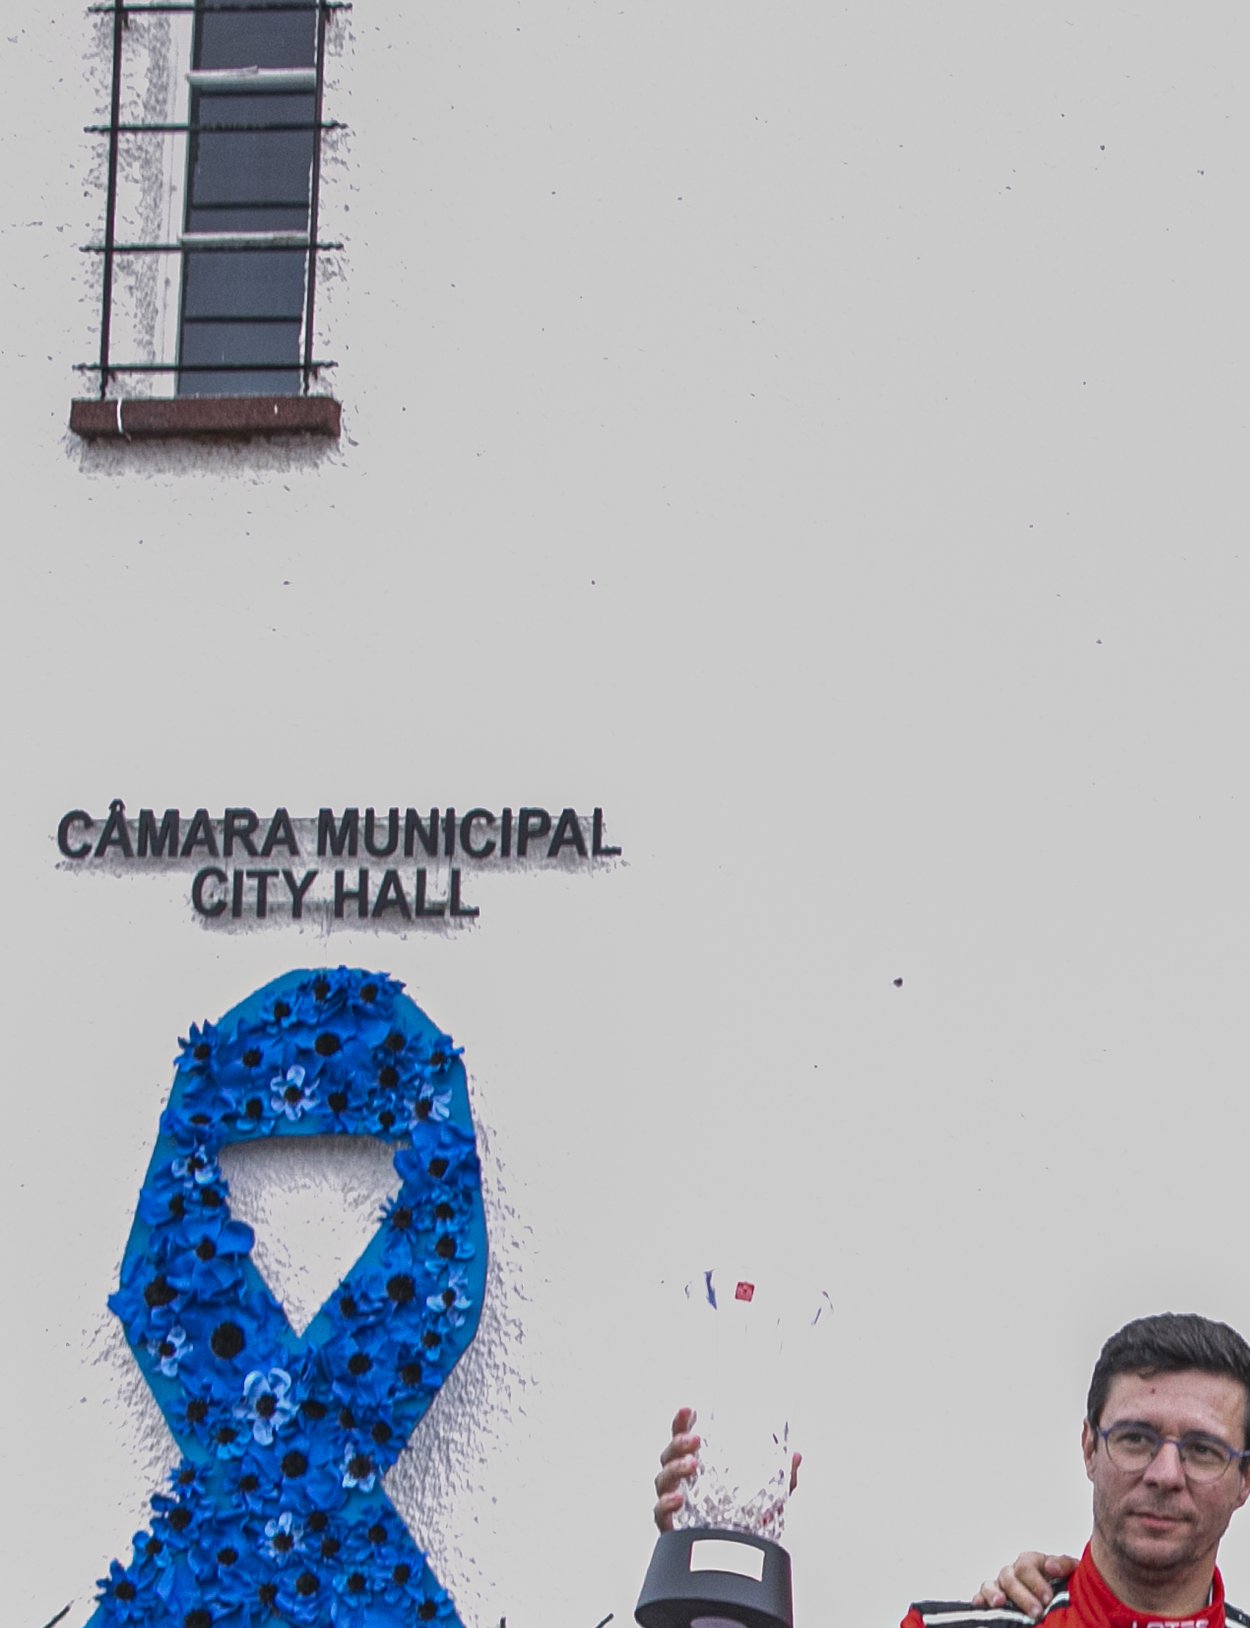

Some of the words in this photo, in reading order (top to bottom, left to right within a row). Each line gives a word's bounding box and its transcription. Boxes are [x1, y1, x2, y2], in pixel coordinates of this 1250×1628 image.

[57, 799, 300, 858] CÂMARA
[317, 807, 621, 858] MUNICIPAL
[191, 868, 318, 919] CITY
[334, 868, 480, 919] HALL
